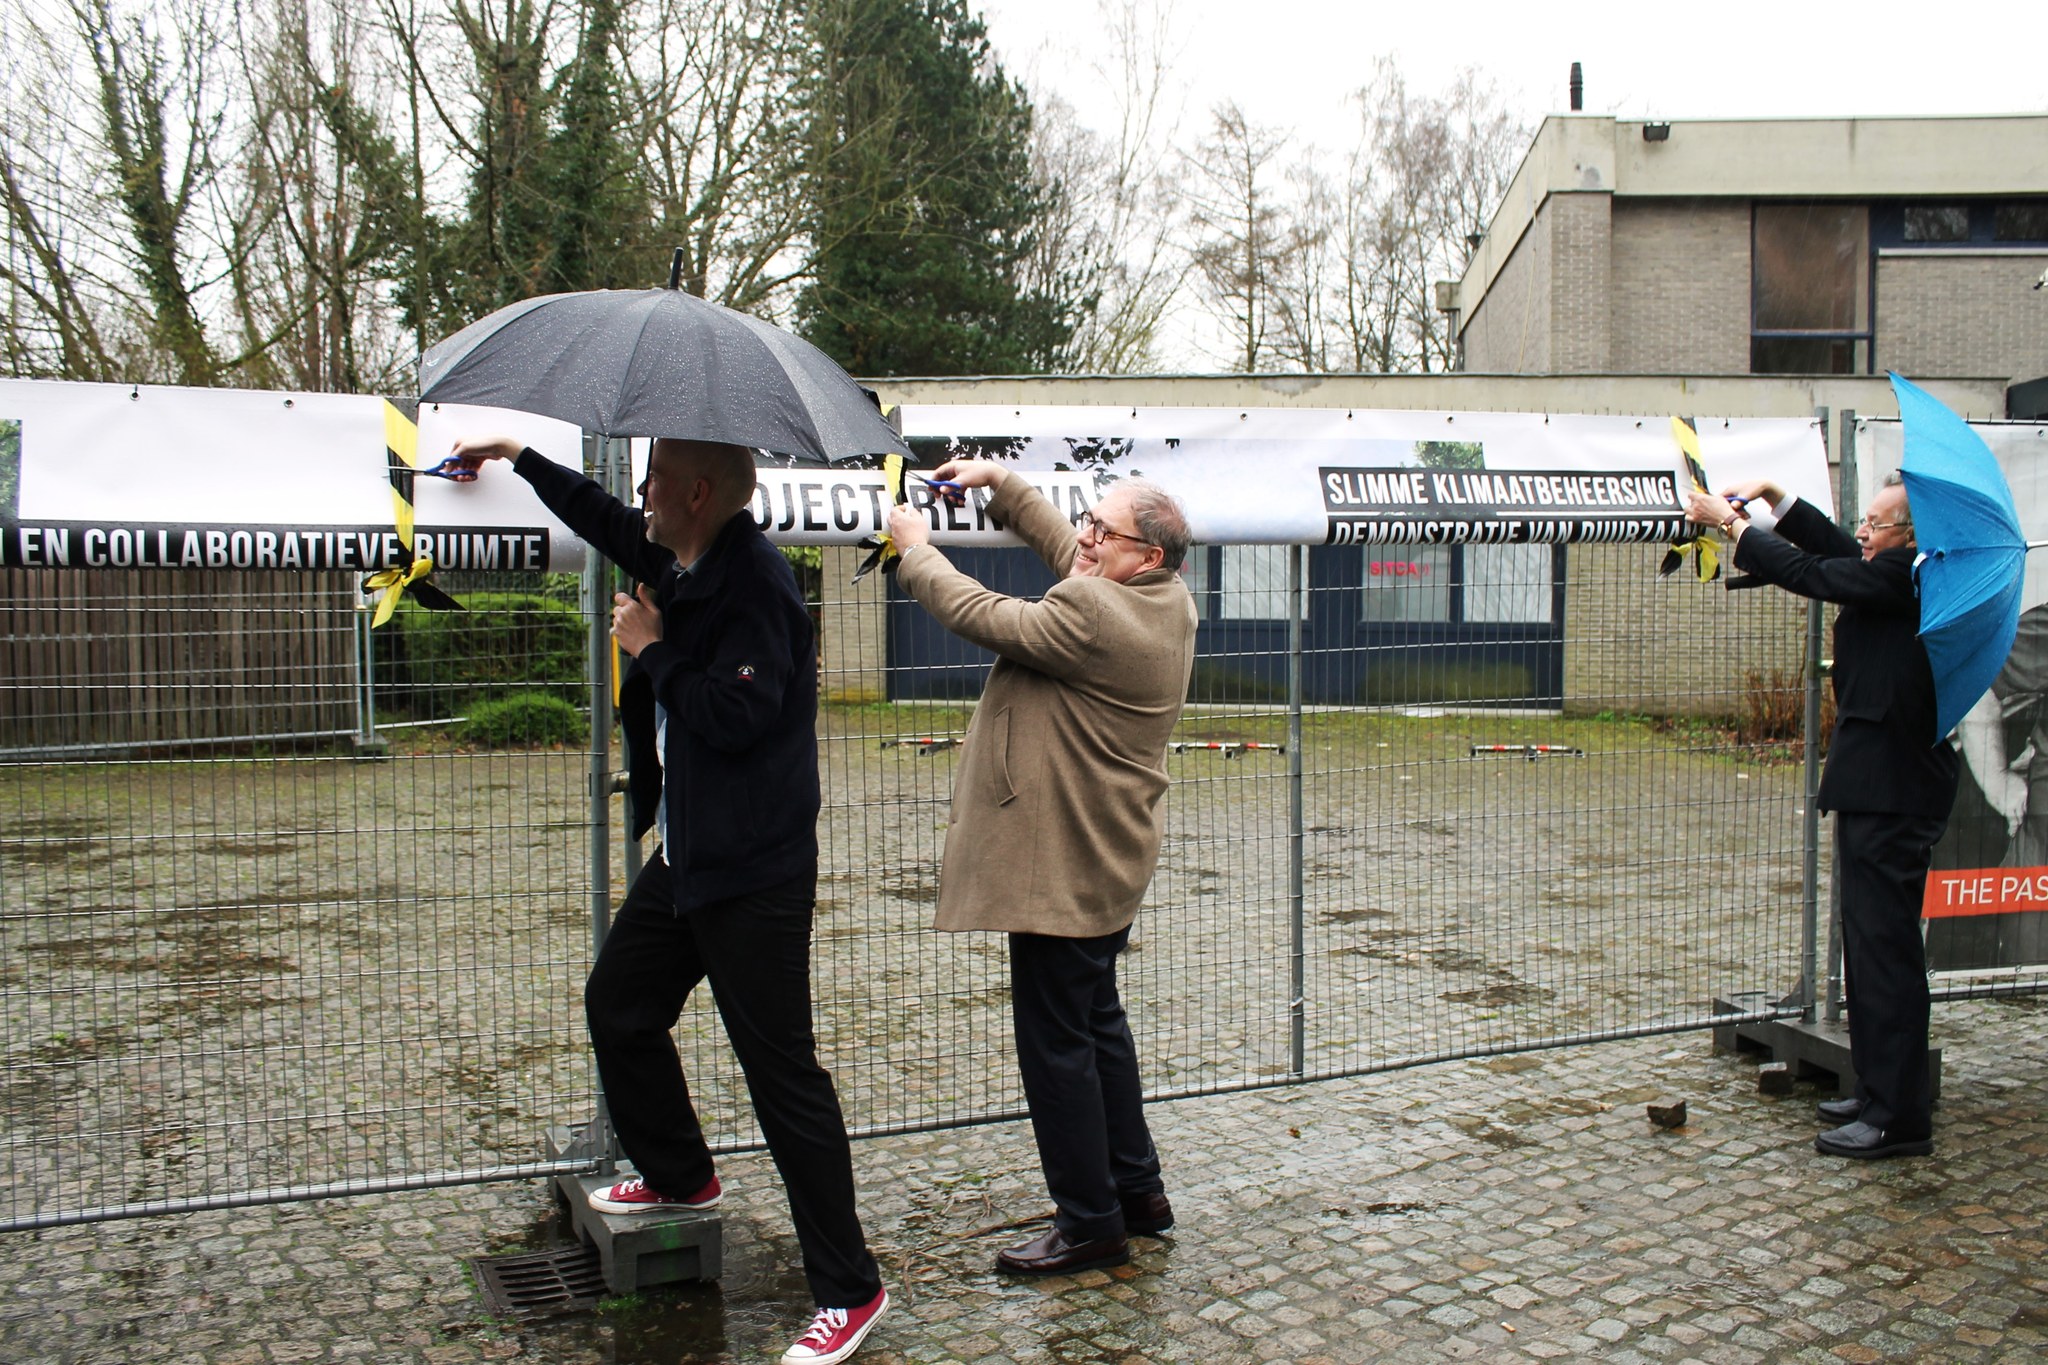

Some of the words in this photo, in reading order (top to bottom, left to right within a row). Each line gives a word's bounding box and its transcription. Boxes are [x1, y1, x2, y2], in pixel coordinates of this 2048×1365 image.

[1326, 472, 1429, 505] SLIMME
[1432, 473, 1675, 506] KLIMAATBEHEERSING
[744, 481, 886, 532] OJECT
[19, 527, 70, 566] EN
[84, 527, 400, 570] COLLABORATIEVE
[414, 532, 543, 570] RUIMTE
[1332, 520, 1522, 545] DEMONSTRATIE
[1527, 520, 1573, 545] VAN
[1941, 877, 1994, 906] THE
[2000, 875, 2048, 903] PAS
